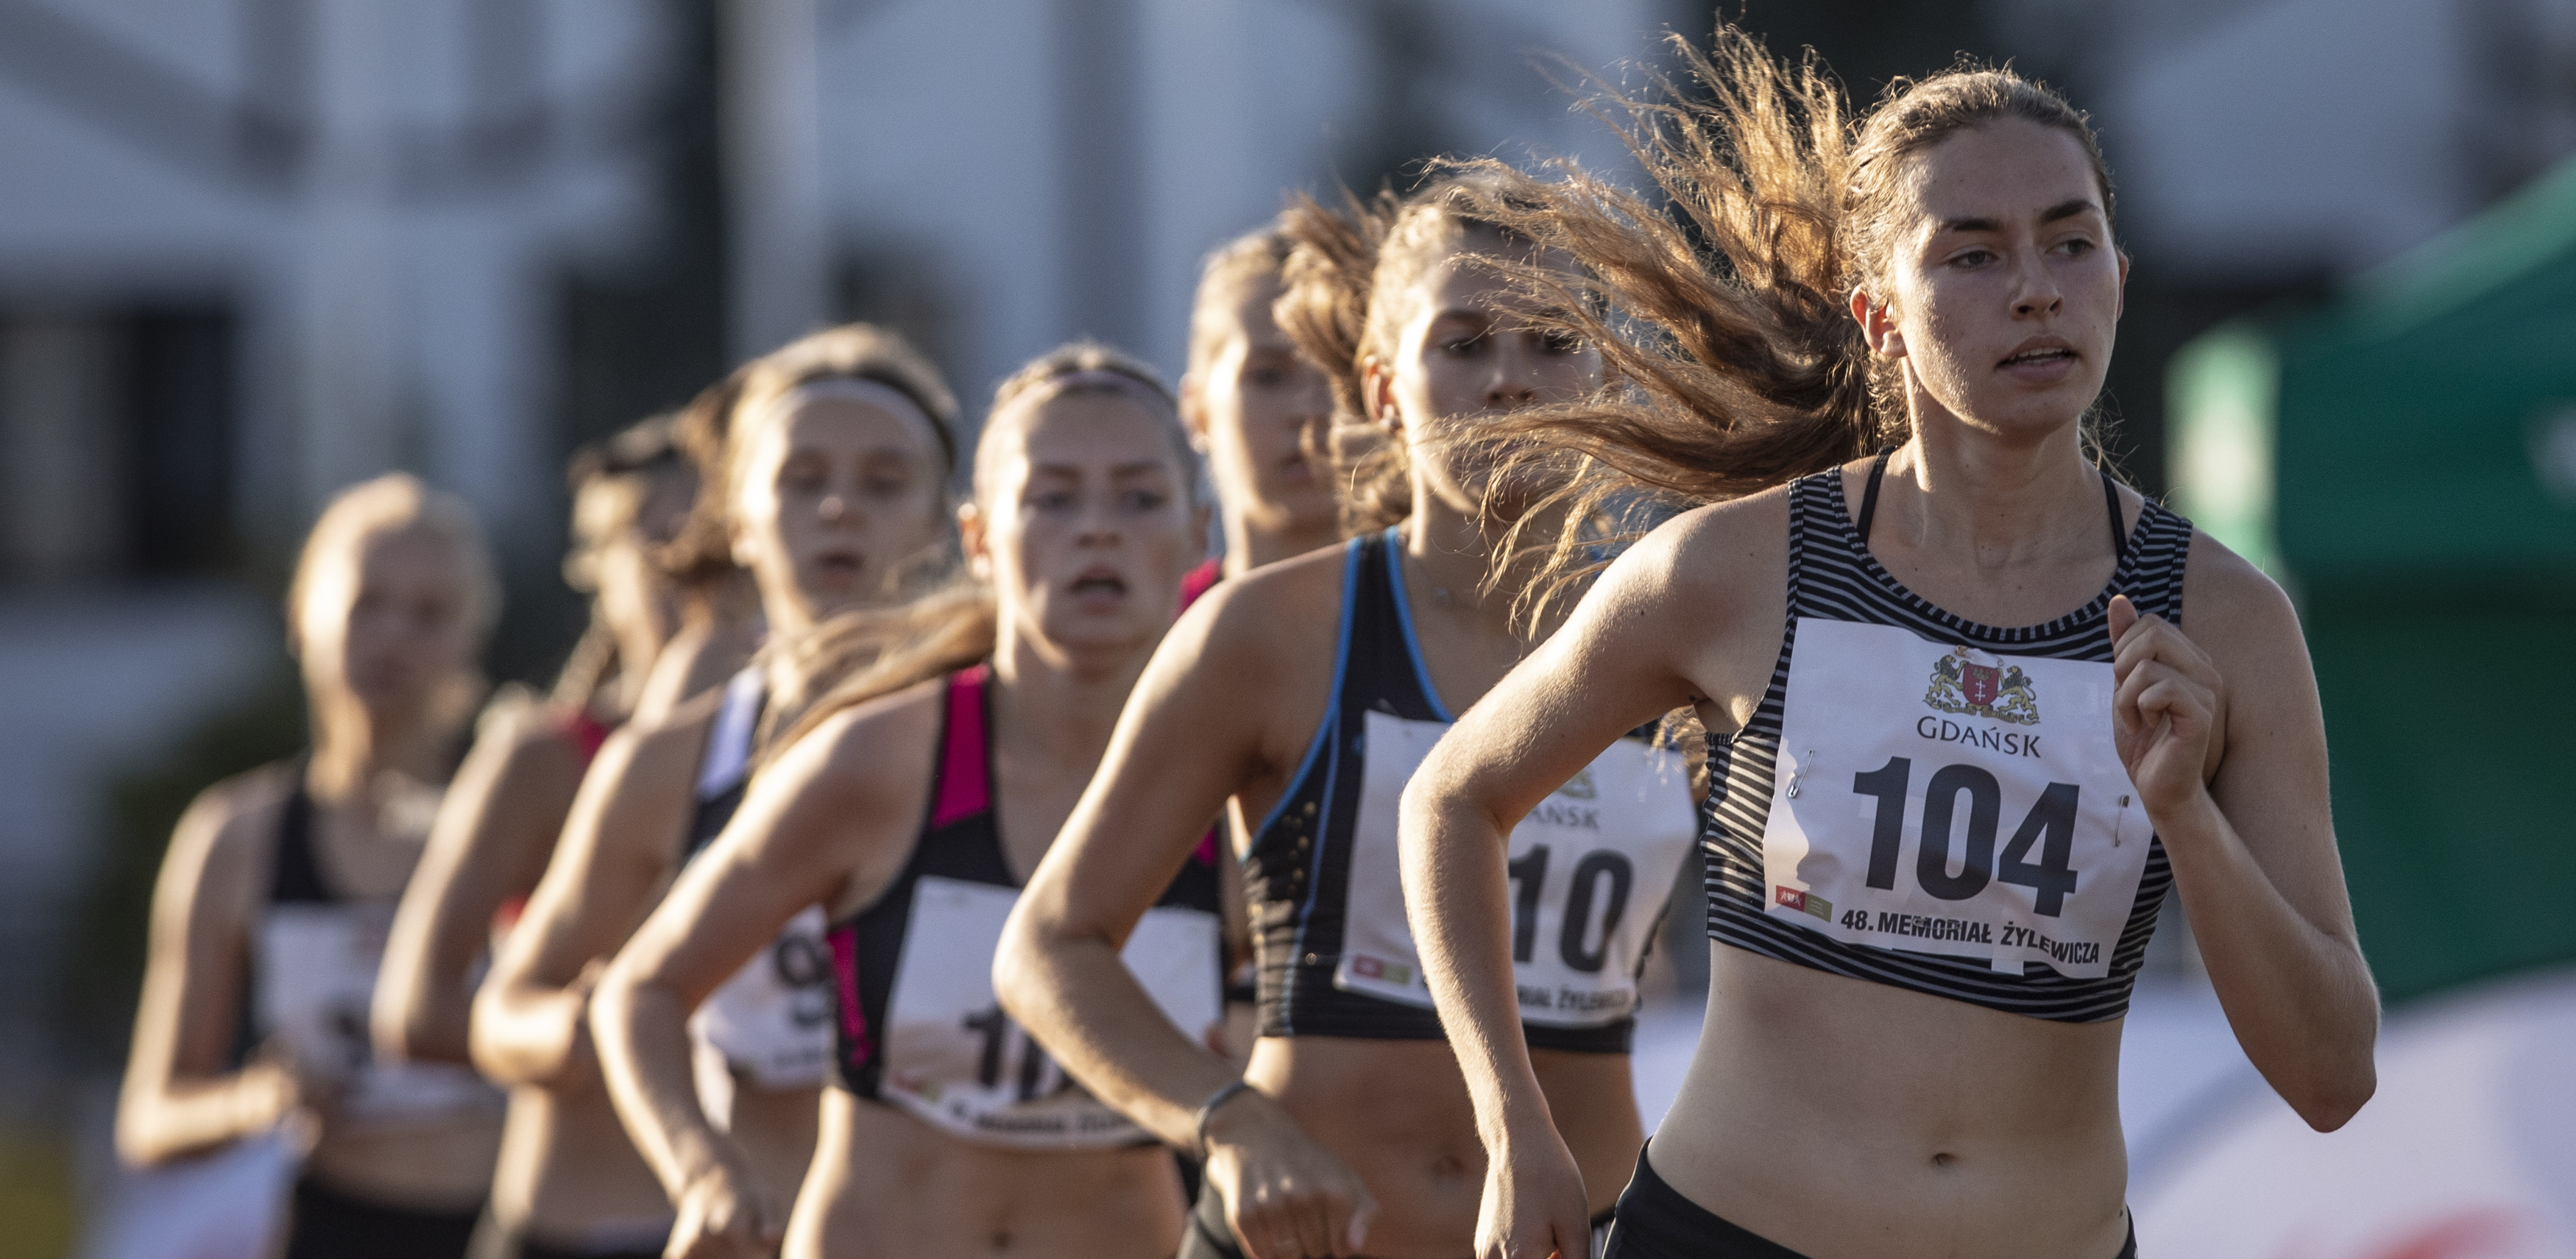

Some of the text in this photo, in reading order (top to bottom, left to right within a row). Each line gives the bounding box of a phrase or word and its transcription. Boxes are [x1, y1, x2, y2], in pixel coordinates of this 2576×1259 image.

[1917, 714, 2041, 758] GDAŃSK
[1853, 756, 2080, 918] 104
[1841, 909, 2100, 964] 48. MEMORIAŁ ŻYLEWICZA
